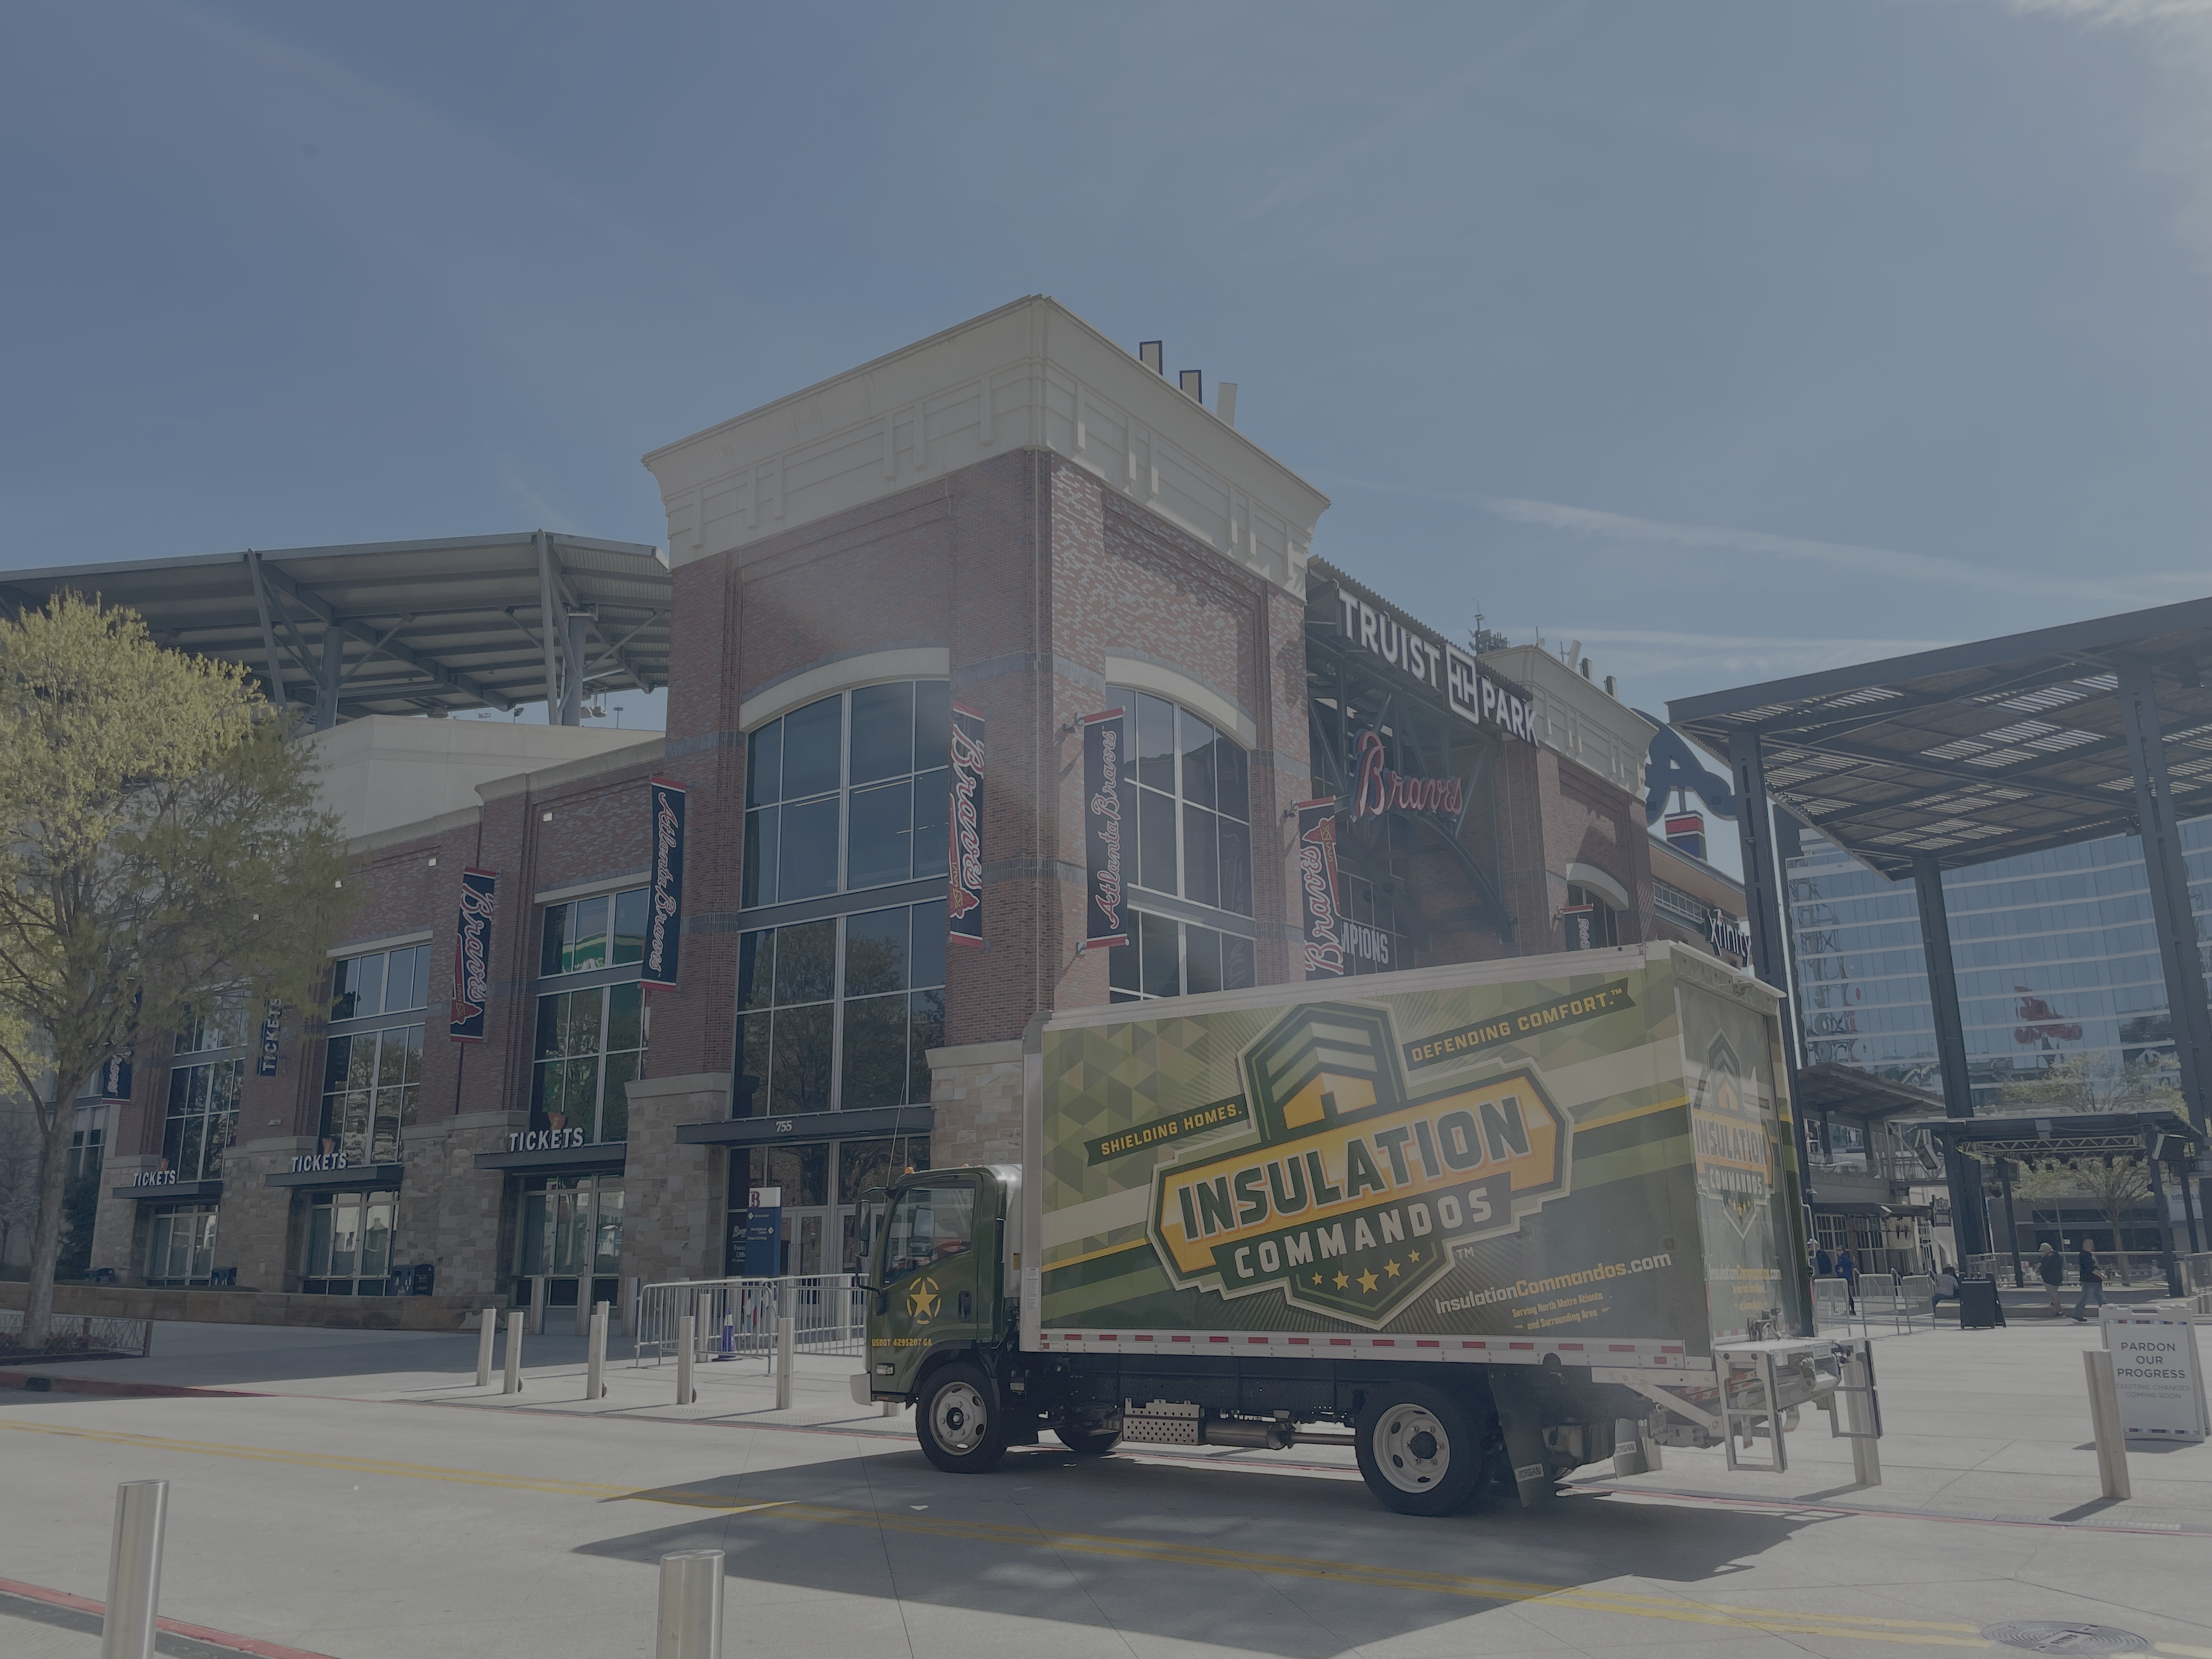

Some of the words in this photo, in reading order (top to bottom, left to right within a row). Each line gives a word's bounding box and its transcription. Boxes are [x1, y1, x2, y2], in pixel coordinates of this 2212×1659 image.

[1339, 588, 1441, 689] TRUIST
[1481, 677, 1539, 748] PARK
[1091, 730, 1121, 821] Braves
[1351, 729, 1464, 822] Braves
[951, 724, 985, 890] Braves
[658, 792, 679, 888] Atlanta
[1096, 819, 1121, 929] Atlanta
[649, 884, 677, 973] Braves
[1300, 845, 1345, 975] Braves
[460, 883, 495, 1002] Braves
[1342, 921, 1390, 964] MPIONS
[1577, 918, 1590, 950] aves
[262, 998, 283, 1071] TICKETS
[1411, 1022, 1511, 1062] DEFENDING
[509, 1127, 584, 1152] TICKETS
[776, 1120, 793, 1132] 755
[1101, 1121, 1178, 1155] SHIELDING
[1183, 1103, 1243, 1131] HOMES.
[1694, 1118, 1768, 1167] INSULATION
[133, 1170, 177, 1187] TICKETS
[291, 1152, 348, 1173] TICKETS
[1177, 1094, 1534, 1243] INSULATION
[1709, 1168, 1763, 1195] COMMANDOS
[1233, 1186, 1493, 1279] COMMANDOS
[1456, 1246, 1475, 1260] TM
[1435, 1252, 1672, 1315] InsulationCommandos.com
[1512, 1306, 1537, 1317] Serving
[1538, 1301, 1556, 1312] North
[1558, 1297, 1578, 1308] Metro
[1578, 1292, 1603, 1304] Atlanta
[1527, 1319, 1539, 1330] and
[1541, 1313, 1582, 1327] Surrounding
[1582, 1309, 1598, 1319] Area
[871, 1338, 891, 1347] USDOT
[923, 1338, 933, 1347] GA
[2121, 1342, 2176, 1352] PARDON
[2136, 1356, 2164, 1365] OUR
[2117, 1368, 2186, 1379] PROGRESS
[1617, 1443, 1635, 1453] ORGAN
[1517, 1465, 1542, 1480] MORGAN
